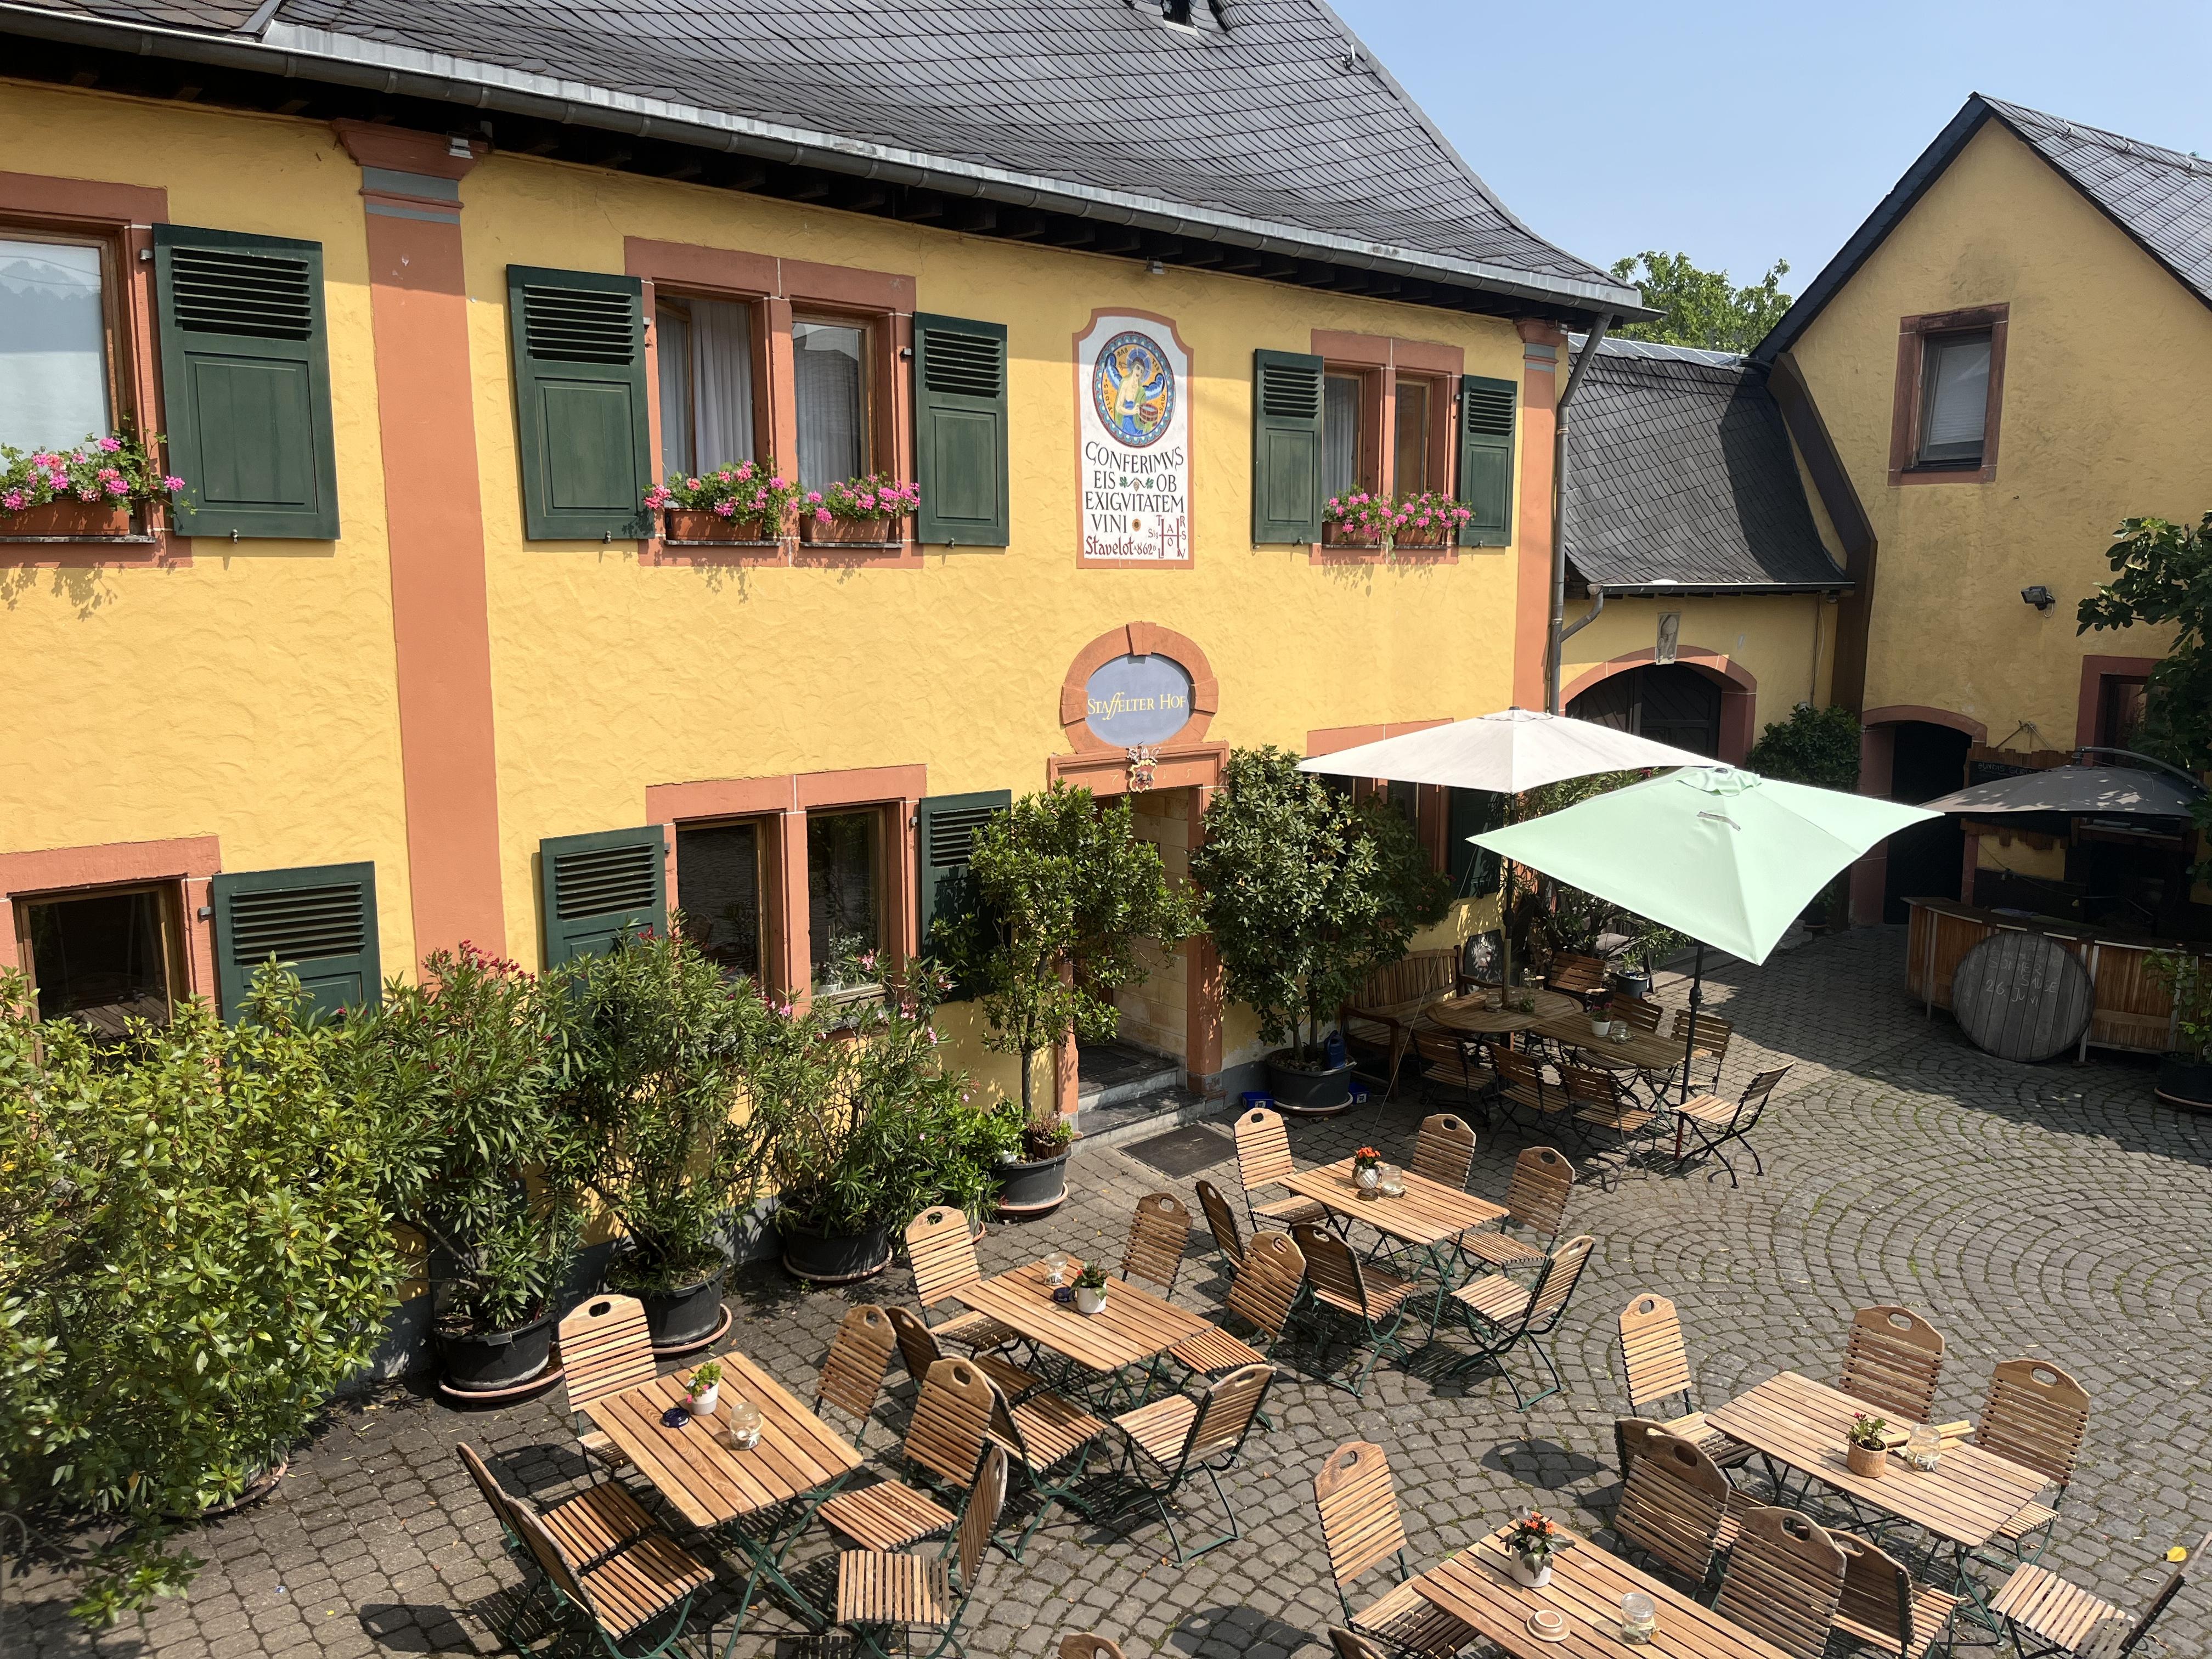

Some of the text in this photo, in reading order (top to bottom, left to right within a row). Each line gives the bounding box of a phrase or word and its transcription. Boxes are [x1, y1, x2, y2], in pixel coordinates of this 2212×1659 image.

[1085, 441, 1184, 475] CONFERIMVS
[1093, 470, 1177, 492] EIS OB
[1085, 491, 1185, 514] EXIGVITATEM
[1091, 514, 1127, 534] VINI
[1085, 535, 1135, 556] Stavelot
